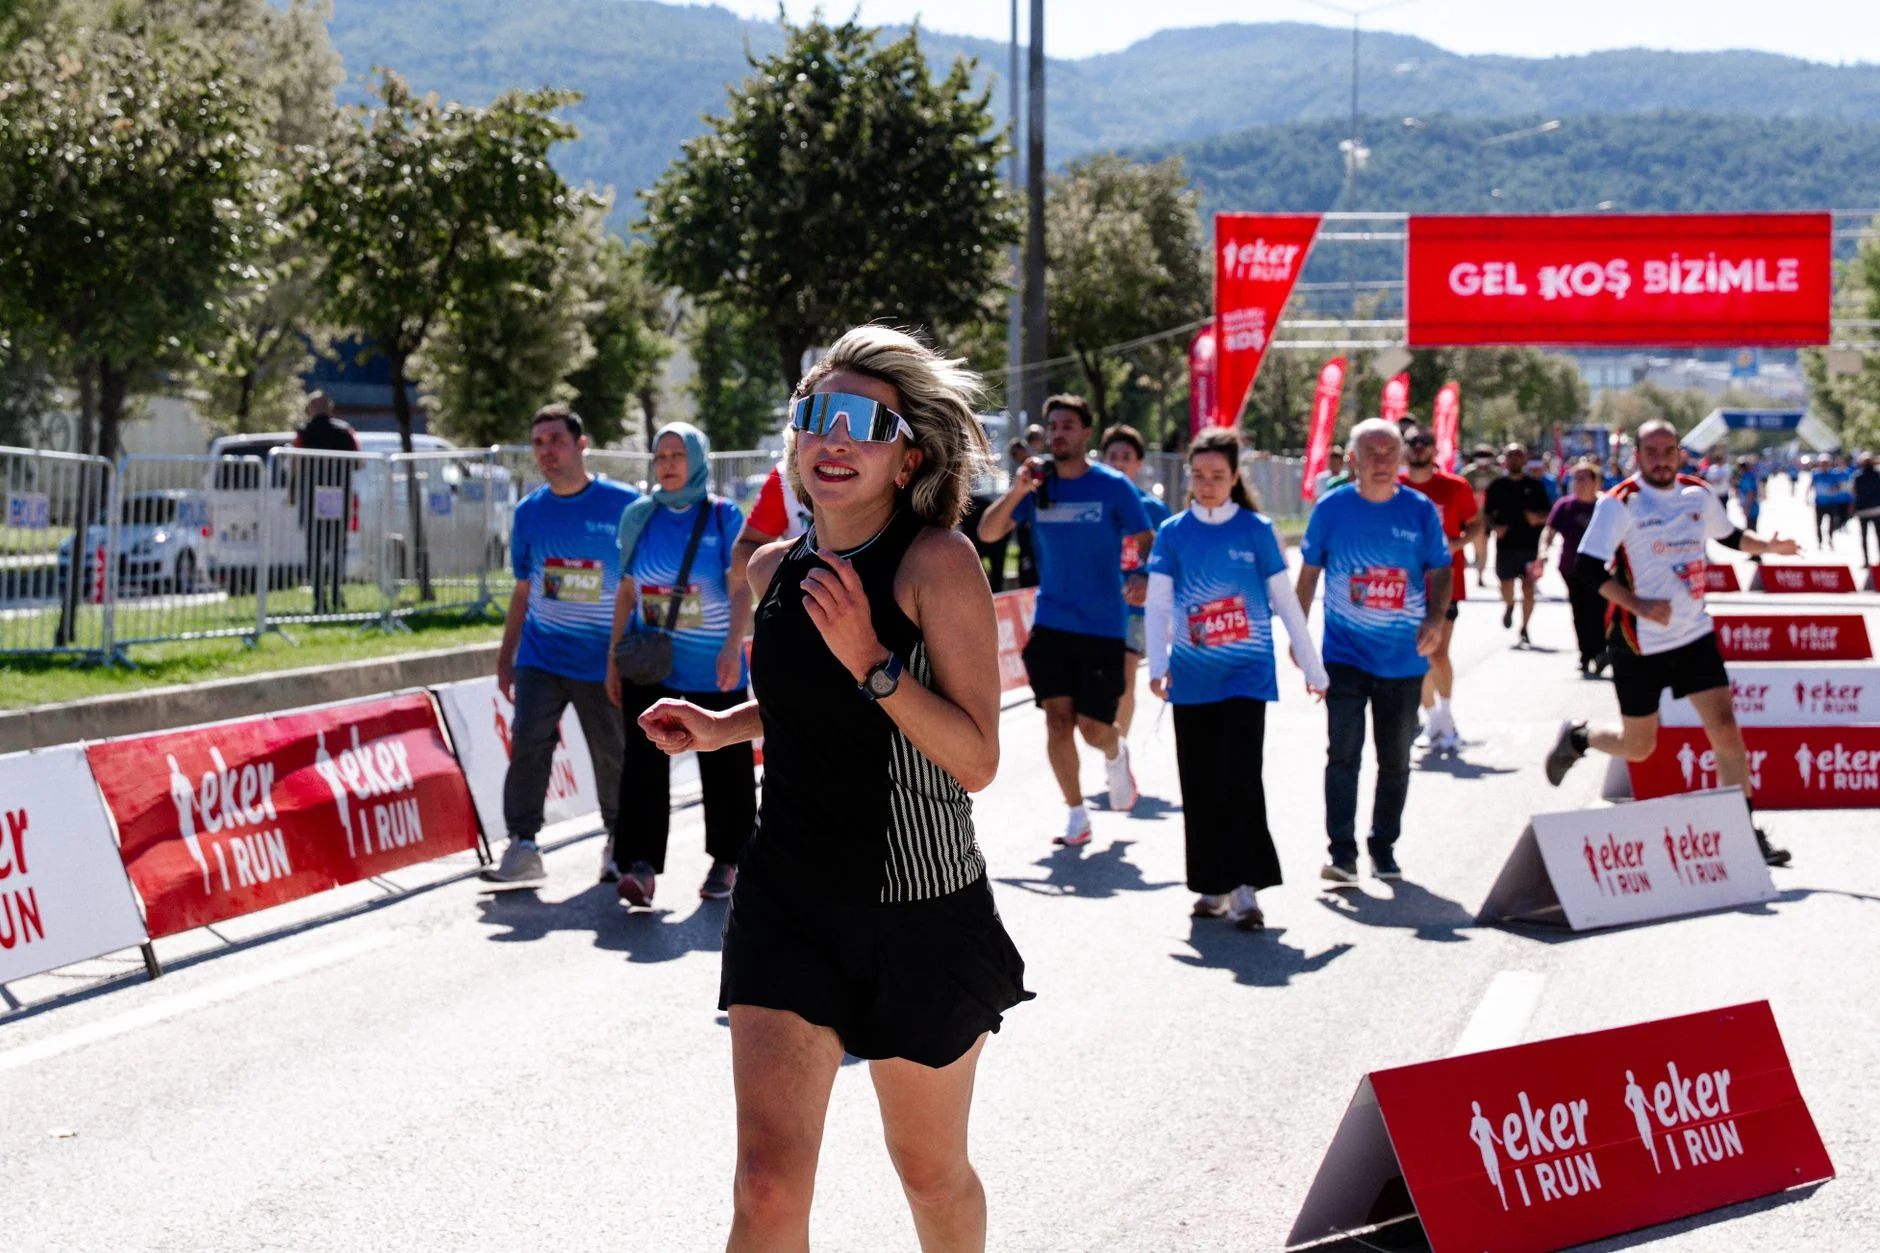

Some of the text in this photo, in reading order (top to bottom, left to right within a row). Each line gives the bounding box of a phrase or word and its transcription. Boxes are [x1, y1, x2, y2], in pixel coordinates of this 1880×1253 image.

[1238, 238, 1299, 264] eker
[1449, 252, 1799, 300] GEL KOŞ BİZİMLE
[1367, 580, 1404, 598] 6667
[1205, 610, 1246, 634] 6675
[1730, 679, 1770, 699] ker
[1810, 680, 1864, 700] eker
[1823, 702, 1859, 713] RUN
[339, 727, 414, 800] eker
[1817, 743, 1880, 772] eker
[202, 746, 277, 834] eker
[1819, 771, 1880, 790] I RUN
[358, 798, 424, 855] I RUN
[1678, 823, 1722, 861] eker
[212, 828, 292, 892] I RUN
[1599, 832, 1645, 871] eker
[1606, 872, 1652, 896] I RUN
[1685, 860, 1729, 885] I RUN
[1655, 1060, 1731, 1127] eker
[1502, 1091, 1589, 1161] eker
[1665, 1119, 1744, 1171] I RUN
[1514, 1152, 1602, 1207] I RUN
